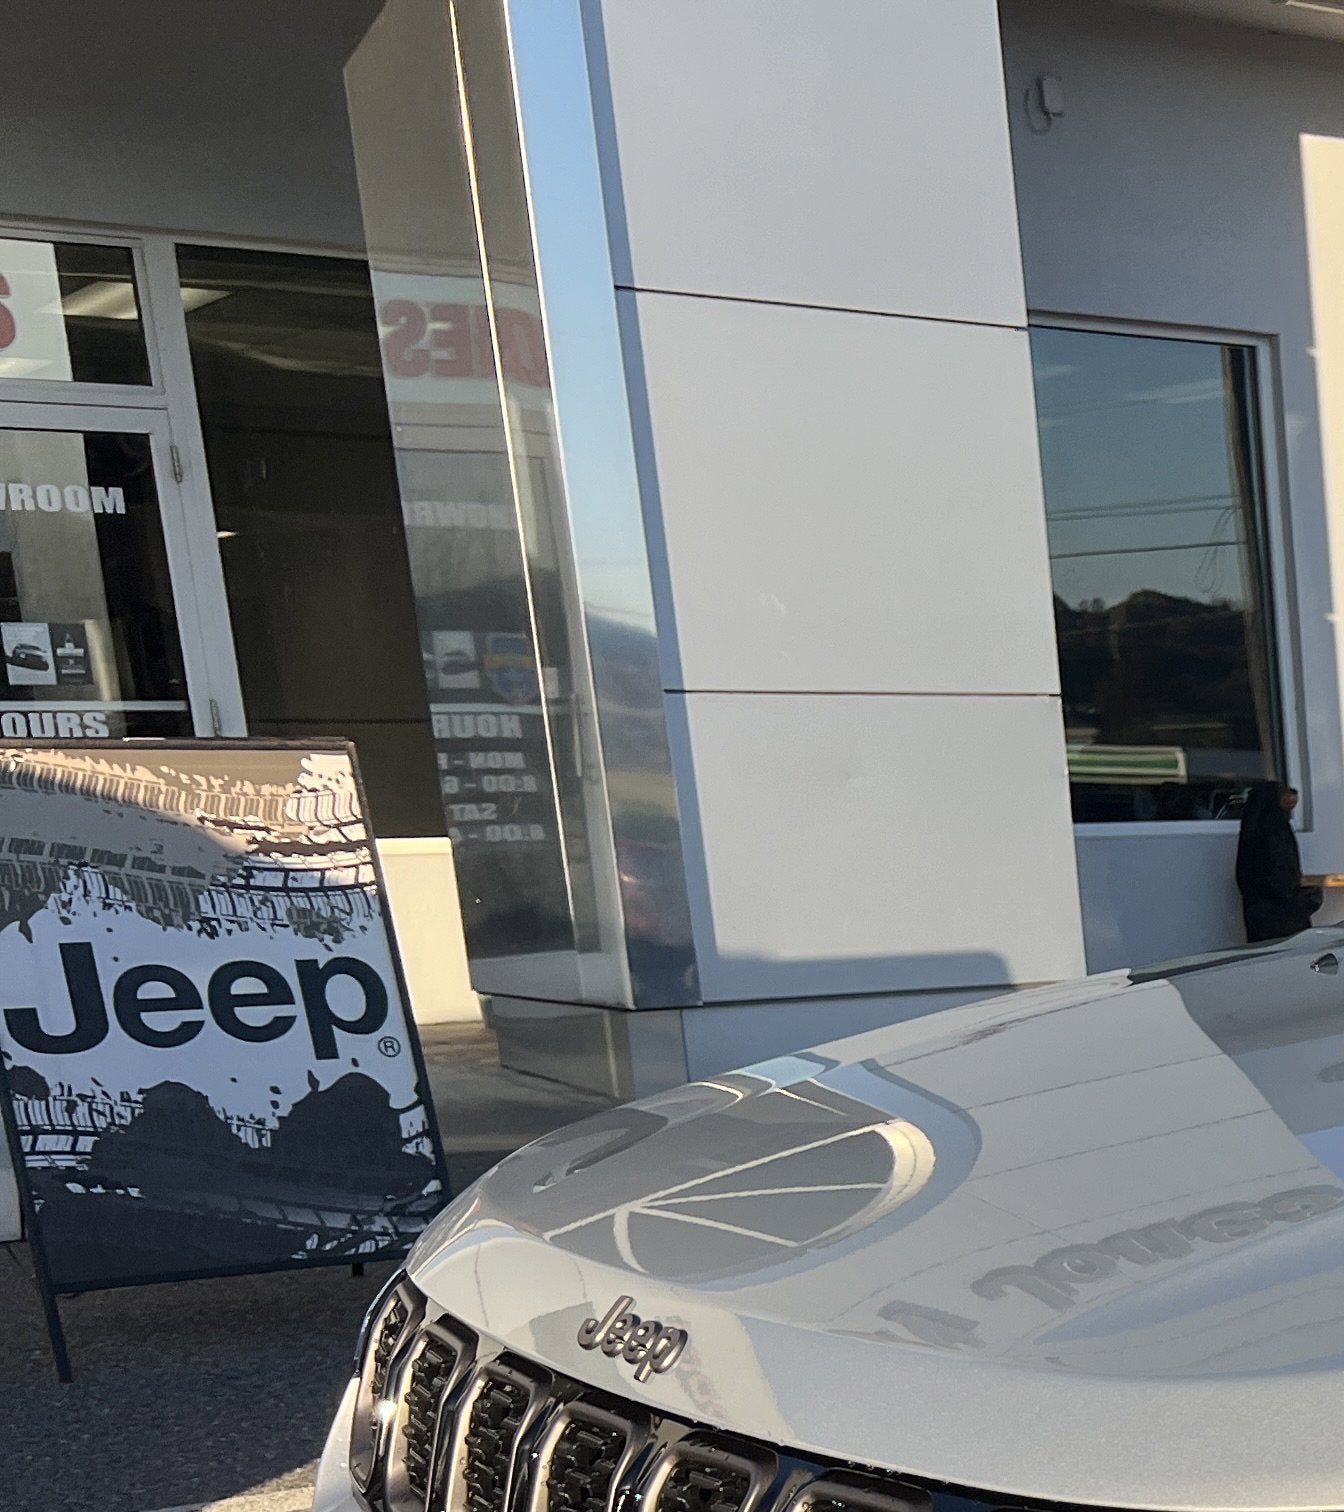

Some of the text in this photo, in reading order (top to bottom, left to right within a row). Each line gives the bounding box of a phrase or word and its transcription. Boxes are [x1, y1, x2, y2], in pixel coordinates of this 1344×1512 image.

[0, 482, 127, 515] ROOM
[0, 711, 111, 739] OURS
[1, 941, 389, 1061] Jeep
[576, 1295, 689, 1384] Jeep
